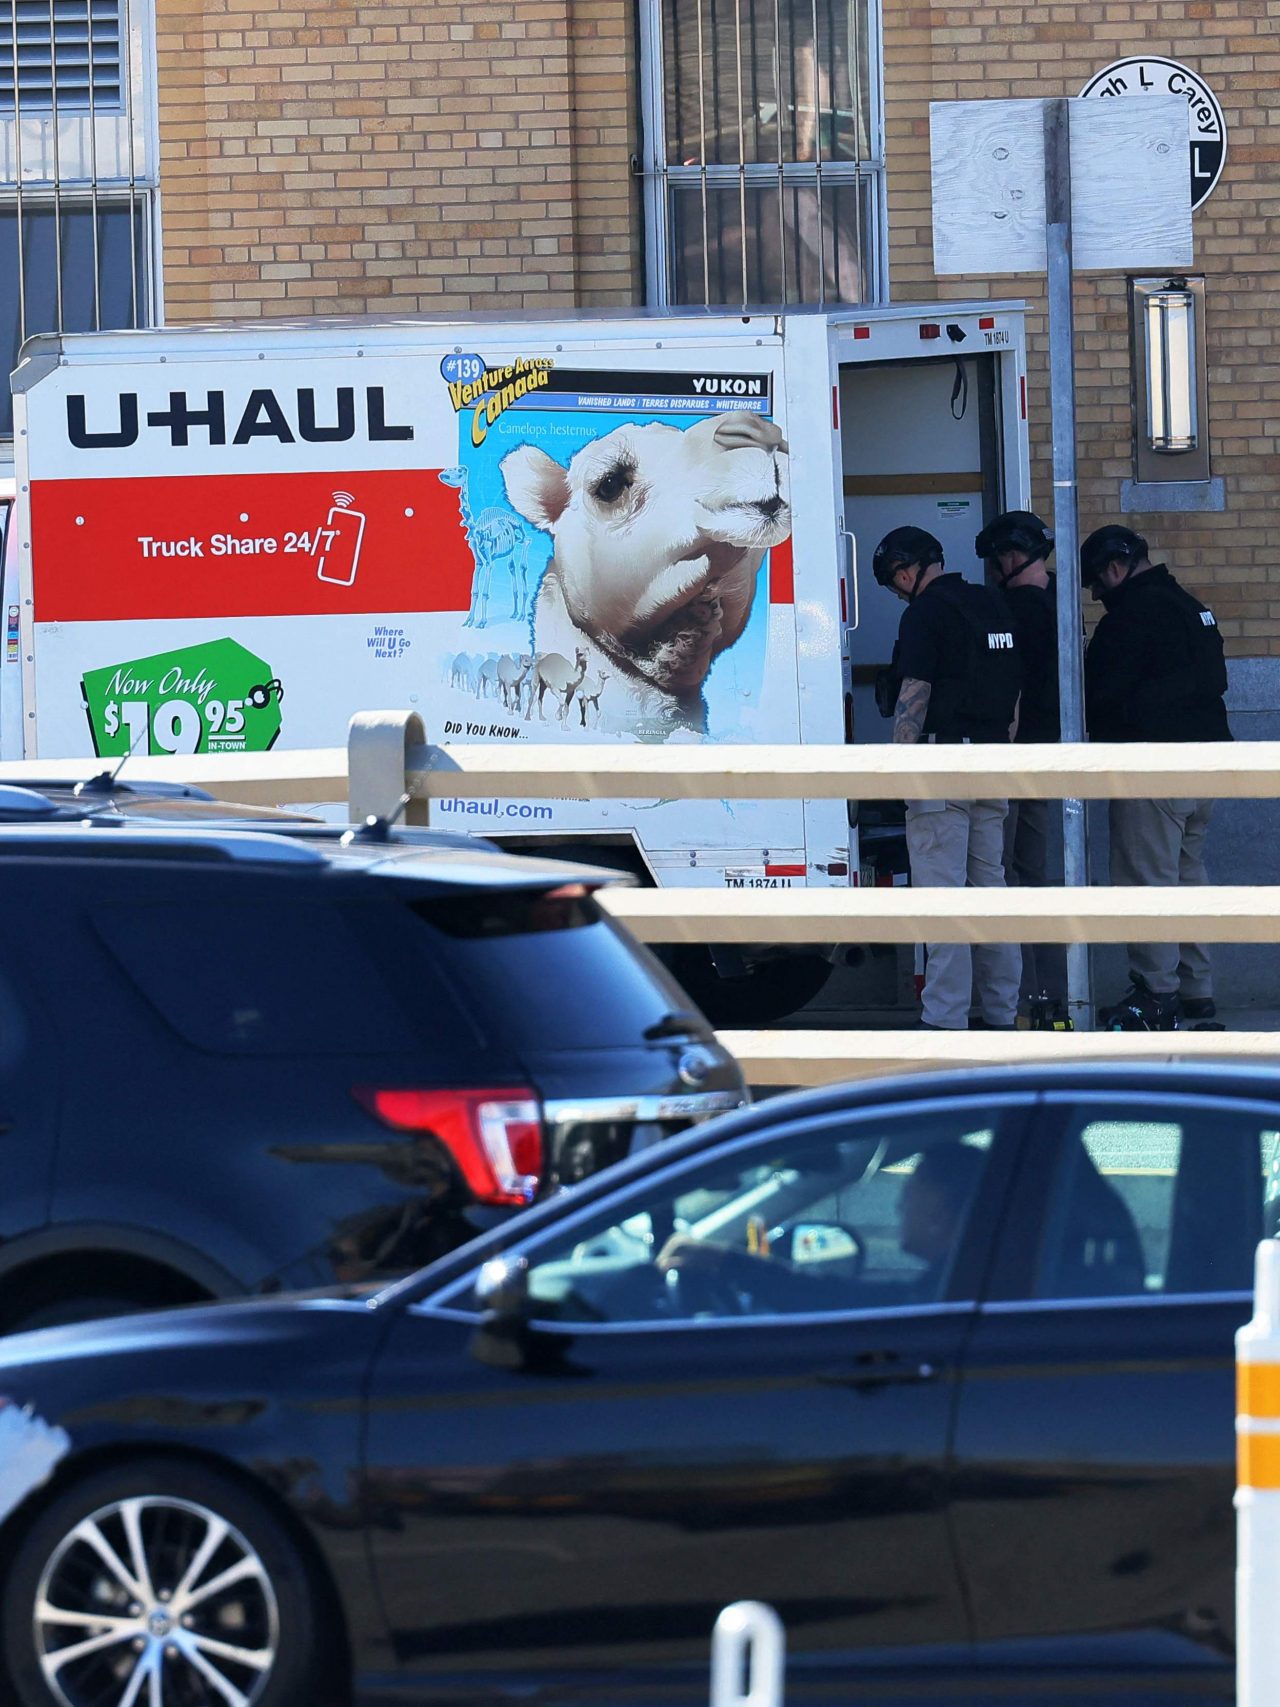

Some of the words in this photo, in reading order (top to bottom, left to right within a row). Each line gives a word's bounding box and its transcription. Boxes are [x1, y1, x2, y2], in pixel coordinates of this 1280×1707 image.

[1167, 73, 1218, 134] Carey
[446, 358, 480, 378] #139
[448, 364, 513, 412] Venture
[515, 356, 555, 375] Across
[692, 377, 761, 395] YUKON
[471, 367, 549, 447] Canada
[578, 396, 612, 407] VANISHED
[613, 397, 636, 408] LANDS
[642, 398, 669, 409] TERRES
[670, 399, 710, 410] DISPARUES
[716, 400, 762, 411] WHITEHORSE
[66, 386, 414, 448] U-HAUL
[498, 421, 547, 437] Camelops
[550, 424, 597, 437] hesternus
[137, 536, 204, 557] Truck
[210, 534, 277, 556] Share
[374, 626, 404, 637] Where
[988, 632, 1014, 649] NYPD
[367, 638, 385, 648] Will
[387, 638, 396, 650] U
[399, 638, 411, 648] Go
[375, 648, 404, 658] Next?
[105, 668, 154, 697] Now
[158, 666, 217, 704] Only
[444, 721, 462, 735] DID
[466, 722, 486, 736] YOU
[489, 724, 528, 739] KNOW...
[208, 741, 246, 750] IN-TOWN
[440, 798, 553, 819] uhaul.com
